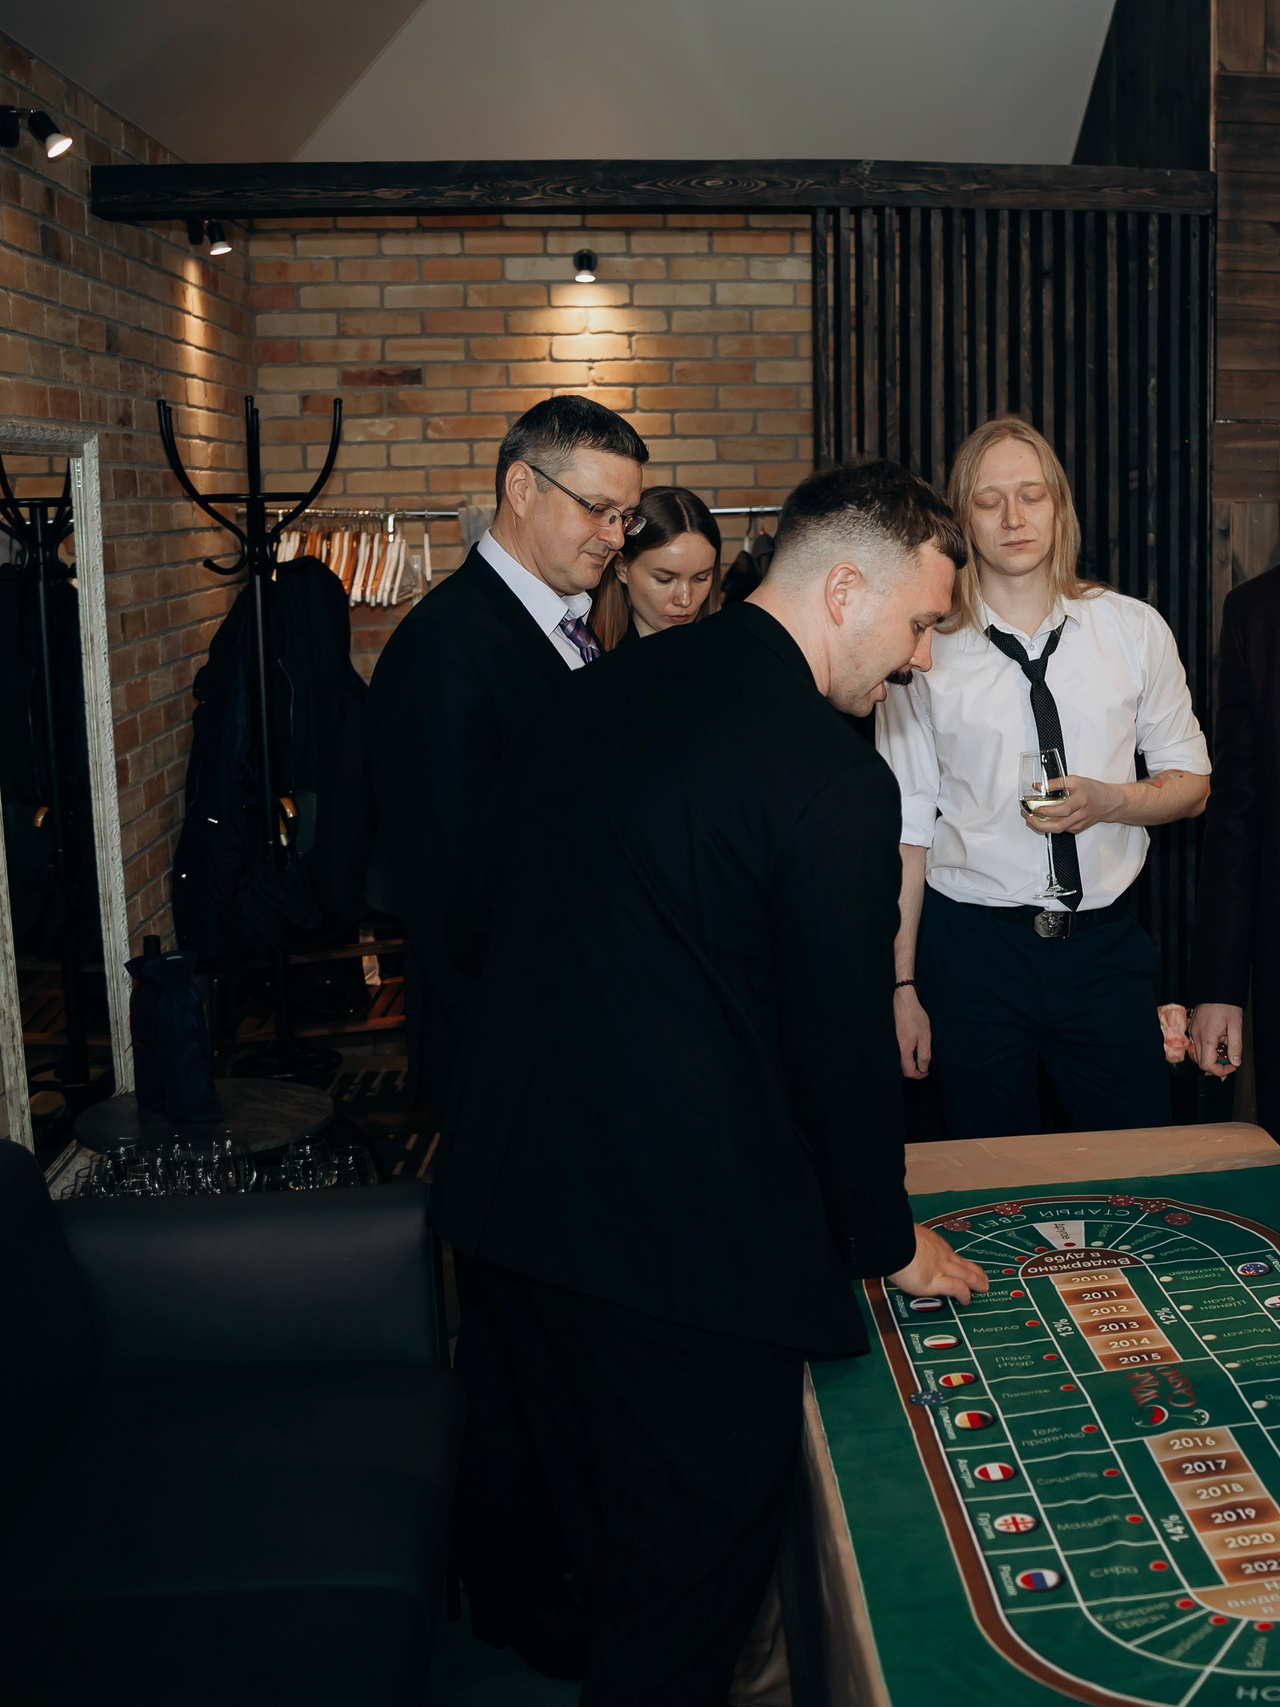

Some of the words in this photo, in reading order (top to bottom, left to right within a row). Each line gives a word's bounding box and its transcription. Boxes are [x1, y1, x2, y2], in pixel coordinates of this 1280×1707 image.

[1039, 1208, 1130, 1219] СТАРЫЙ
[978, 1214, 1027, 1229] СВЕТ
[1027, 1257, 1131, 1273] Выдержано
[1044, 1252, 1085, 1264] дубе
[1071, 1274, 1109, 1283] 2010
[1181, 1272, 1222, 1281] Грюнер
[1082, 1290, 1118, 1301] 2011
[1090, 1305, 1129, 1316] 2012
[1199, 1299, 1247, 1311] Шенен
[1154, 1307, 1178, 1325] 12%
[973, 1325, 1020, 1333] Мерло
[1052, 1318, 1075, 1337] 13%
[1098, 1321, 1140, 1333] 2013
[1222, 1327, 1272, 1338] Мускат
[910, 1333, 924, 1354] Италия
[1109, 1337, 1151, 1349] 2014
[995, 1354, 1031, 1362] Пино
[1119, 1353, 1161, 1365] 2015
[923, 1369, 939, 1393] Испани
[1124, 1369, 1161, 1406] WINE
[1001, 1389, 1051, 1399] Пинотаж
[938, 1406, 957, 1440] Германия
[1021, 1431, 1086, 1447] пранильо
[1169, 1436, 1217, 1451] 2016
[956, 1458, 976, 1489] Австрия
[1181, 1458, 1228, 1475] 2017
[1195, 1482, 1245, 1500] 2018
[1057, 1514, 1120, 1531] Мальбек
[1211, 1507, 1257, 1524] 2019
[976, 1512, 996, 1540] Грузия
[1160, 1513, 1190, 1542] 14%
[1224, 1531, 1276, 1549] 2020
[1089, 1565, 1139, 1578] Сира
[998, 1564, 1018, 1596] Россия
[1261, 1605, 1275, 1615] в
